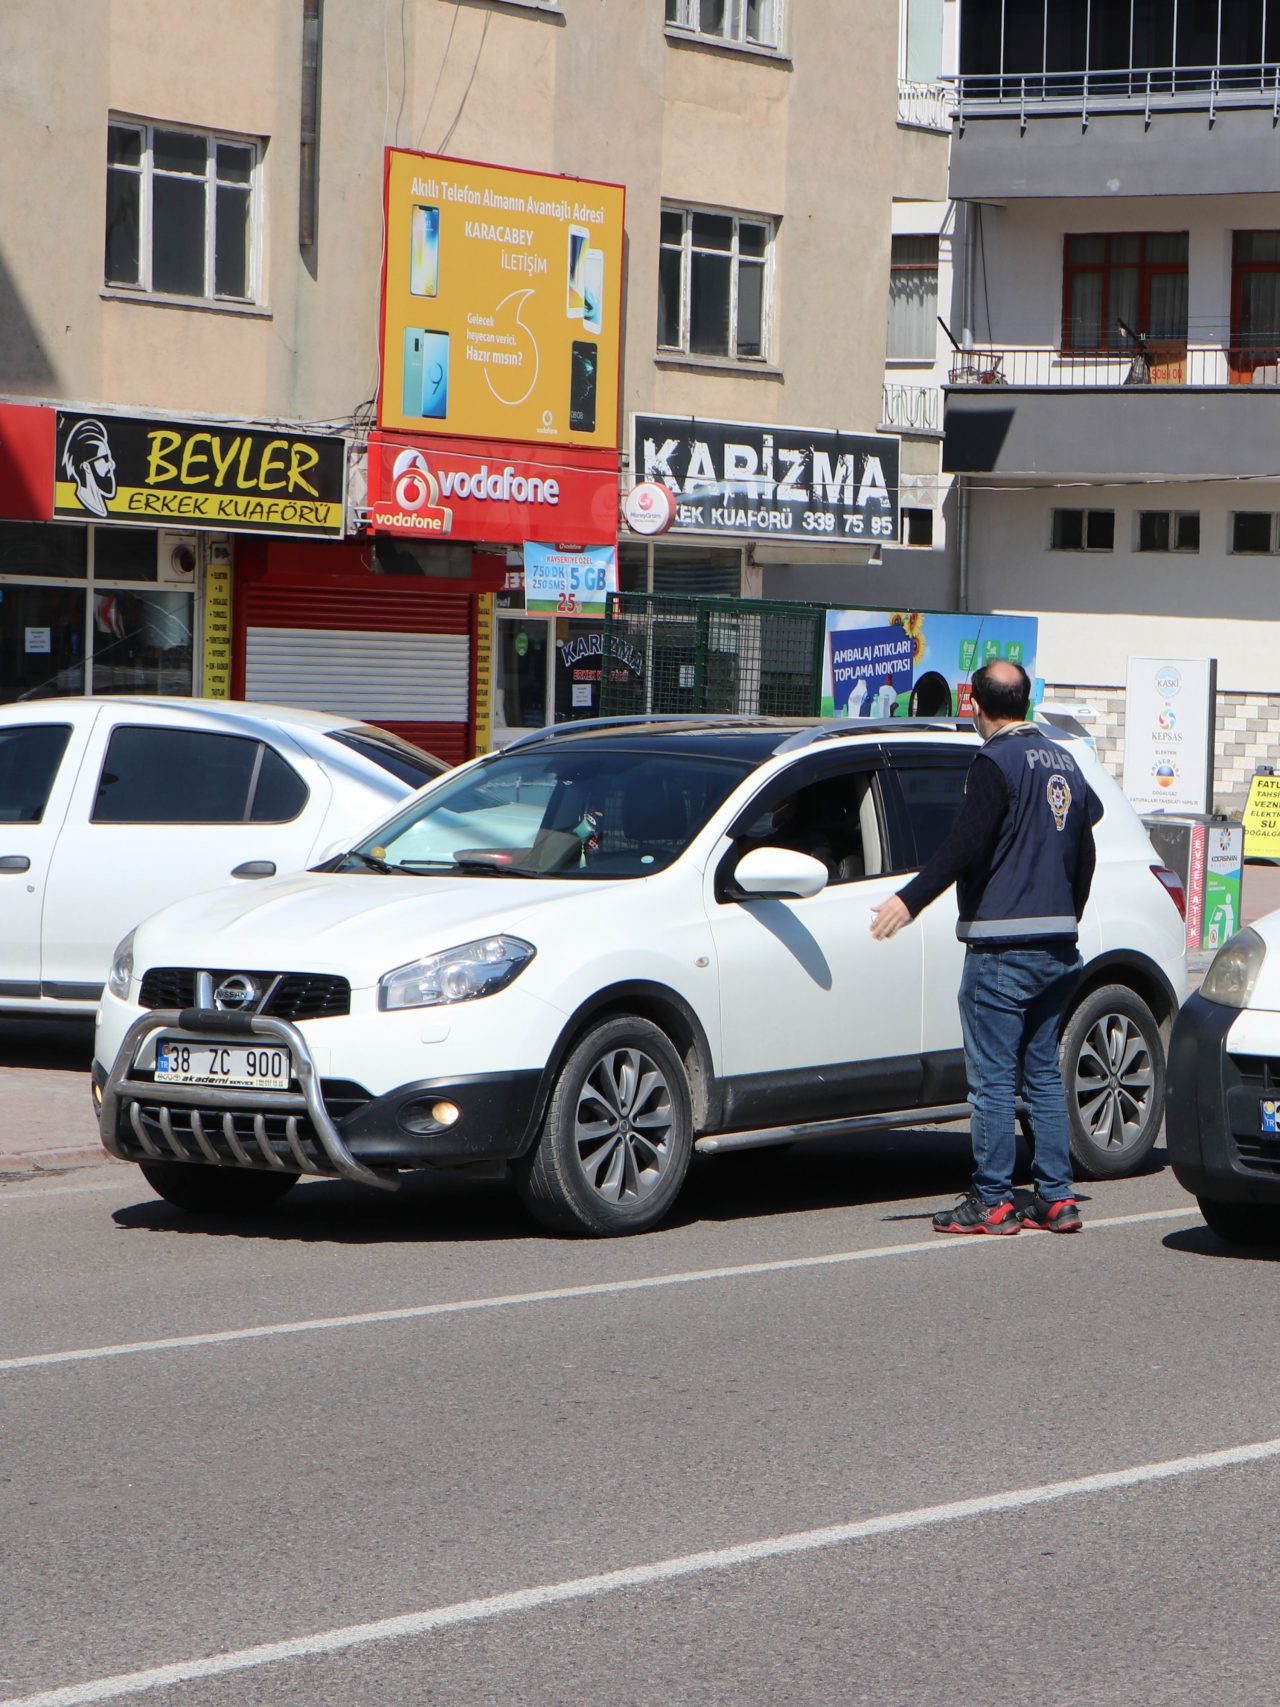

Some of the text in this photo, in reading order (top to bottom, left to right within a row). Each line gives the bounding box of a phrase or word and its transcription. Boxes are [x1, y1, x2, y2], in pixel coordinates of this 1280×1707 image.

[411, 177, 605, 224] Akıllı Telefon Almanın Avantajlı Adresi
[465, 221, 534, 246] KARACABEY
[501, 249, 547, 276] İLETİŞİM
[467, 312, 495, 327] Gelecek
[466, 329, 495, 344] heyecan
[466, 345, 523, 366] Hazır mısın?
[145, 430, 319, 497] BEYLER
[644, 434, 891, 508] KARİZMA
[438, 464, 559, 505] vodafone
[128, 492, 331, 524] ERKEK KUAFÖRÜ
[673, 505, 704, 525] KEK
[711, 506, 792, 530] KUAFÖRÜ
[802, 512, 834, 532] 339
[843, 514, 864, 533] 75
[375, 511, 441, 531] vodafone
[533, 566, 565, 578] 750 DK
[570, 567, 606, 591] 5 GB
[532, 579, 547, 589] 250
[548, 579, 565, 590] SMS
[562, 633, 643, 676] KARZMA
[834, 640, 911, 664] AMBALAJ ATIKLARI
[834, 658, 911, 682] TOPLAMA NOKTASI
[1158, 677, 1179, 688] KASKİ
[1025, 749, 1075, 772] POLİS
[1261, 820, 1276, 828] SU
[1194, 840, 1202, 890] EVSEL
[1190, 896, 1200, 937] ATIK
[170, 1046, 190, 1072] 38
[209, 1049, 231, 1075] ZC
[246, 1051, 281, 1077] 900
[1265, 1119, 1275, 1127] TR
